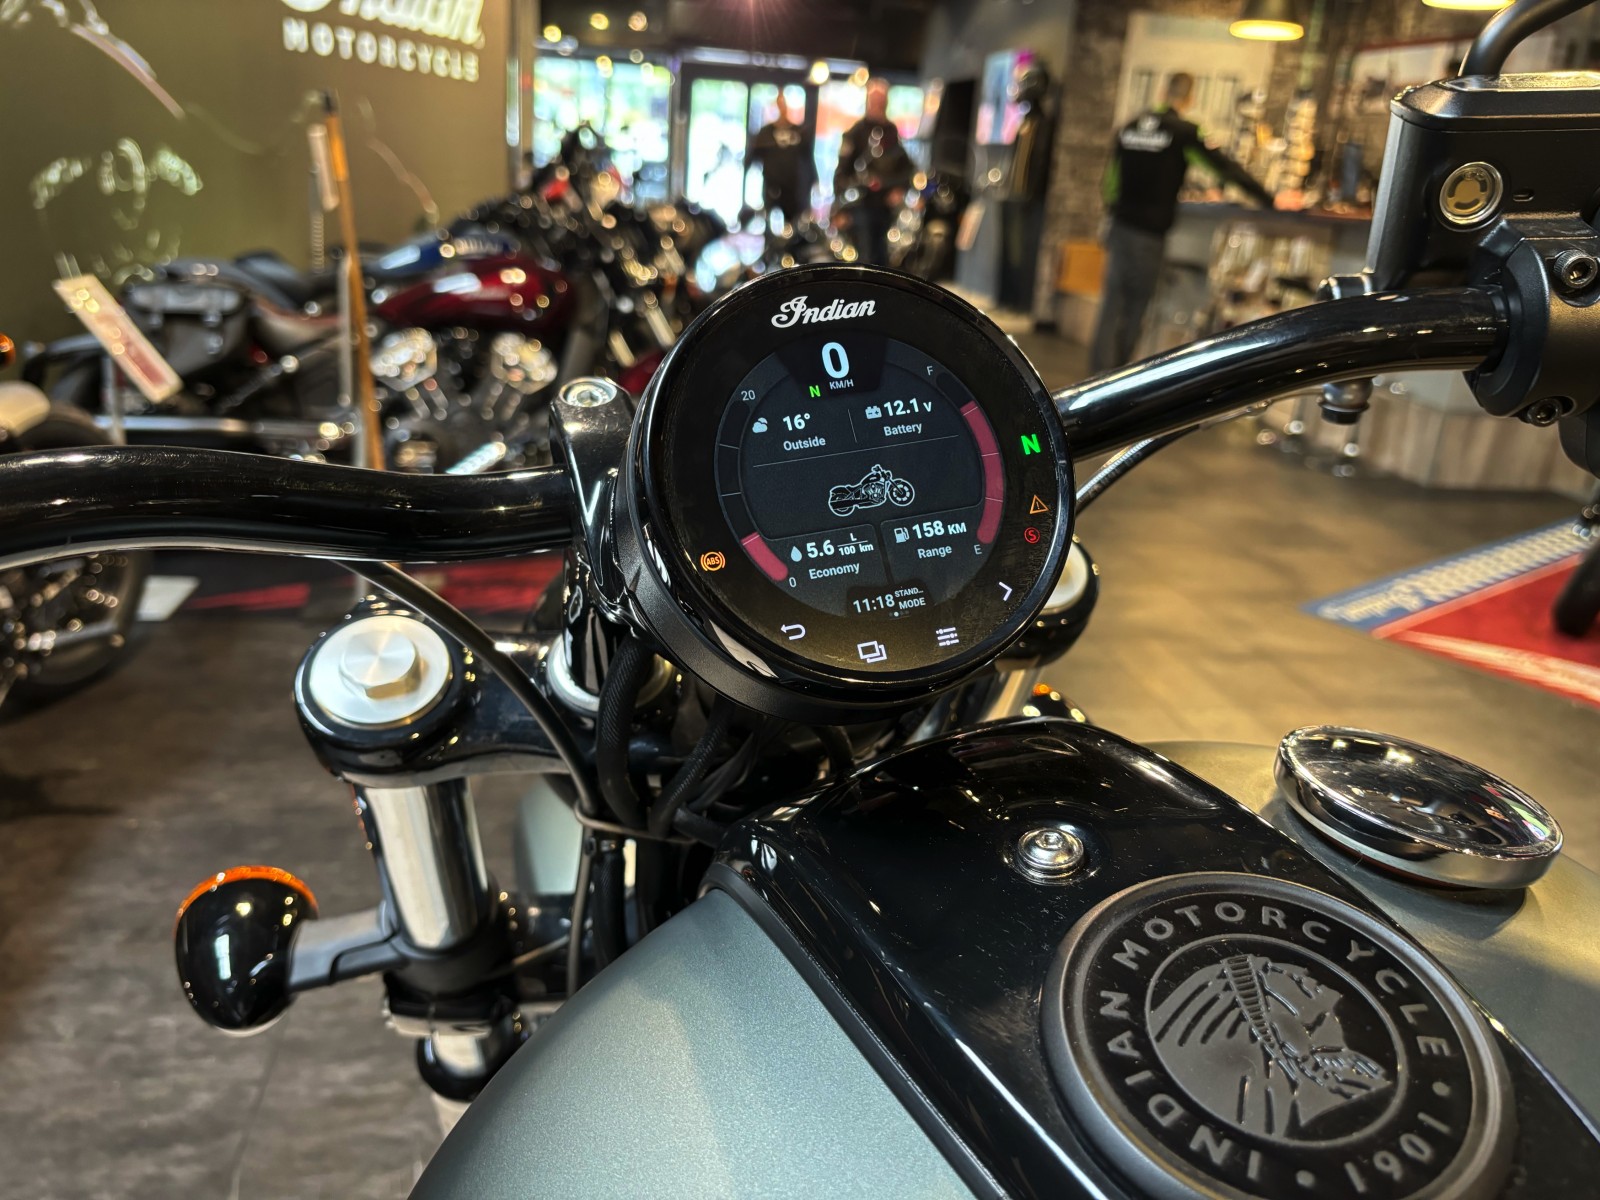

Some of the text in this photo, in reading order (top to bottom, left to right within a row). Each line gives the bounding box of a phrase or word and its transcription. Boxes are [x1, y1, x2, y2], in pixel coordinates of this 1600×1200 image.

[282, 16, 480, 83] MOTORCYCLE
[771, 295, 877, 328] Indian
[821, 341, 850, 379] 0
[926, 365, 934, 376] F
[808, 385, 821, 398] N
[829, 378, 855, 390] KM/H
[740, 389, 756, 401] 20
[883, 397, 920, 417] 12.1
[883, 423, 923, 437] Battery
[783, 435, 826, 451] Outside
[1020, 433, 1041, 455] N
[912, 520, 967, 540] 158 KM
[806, 539, 835, 559] 5.6
[838, 542, 874, 556] 100 km
[917, 544, 953, 559] Range
[974, 544, 983, 555] E
[808, 563, 860, 580] Economy
[788, 576, 798, 588] 0
[853, 594, 896, 614] 11:18
[898, 597, 926, 610] MODE
[1099, 901, 1452, 1180] INDIAN MOTORCYCLE
[1344, 1111, 1452, 1194] 1901
